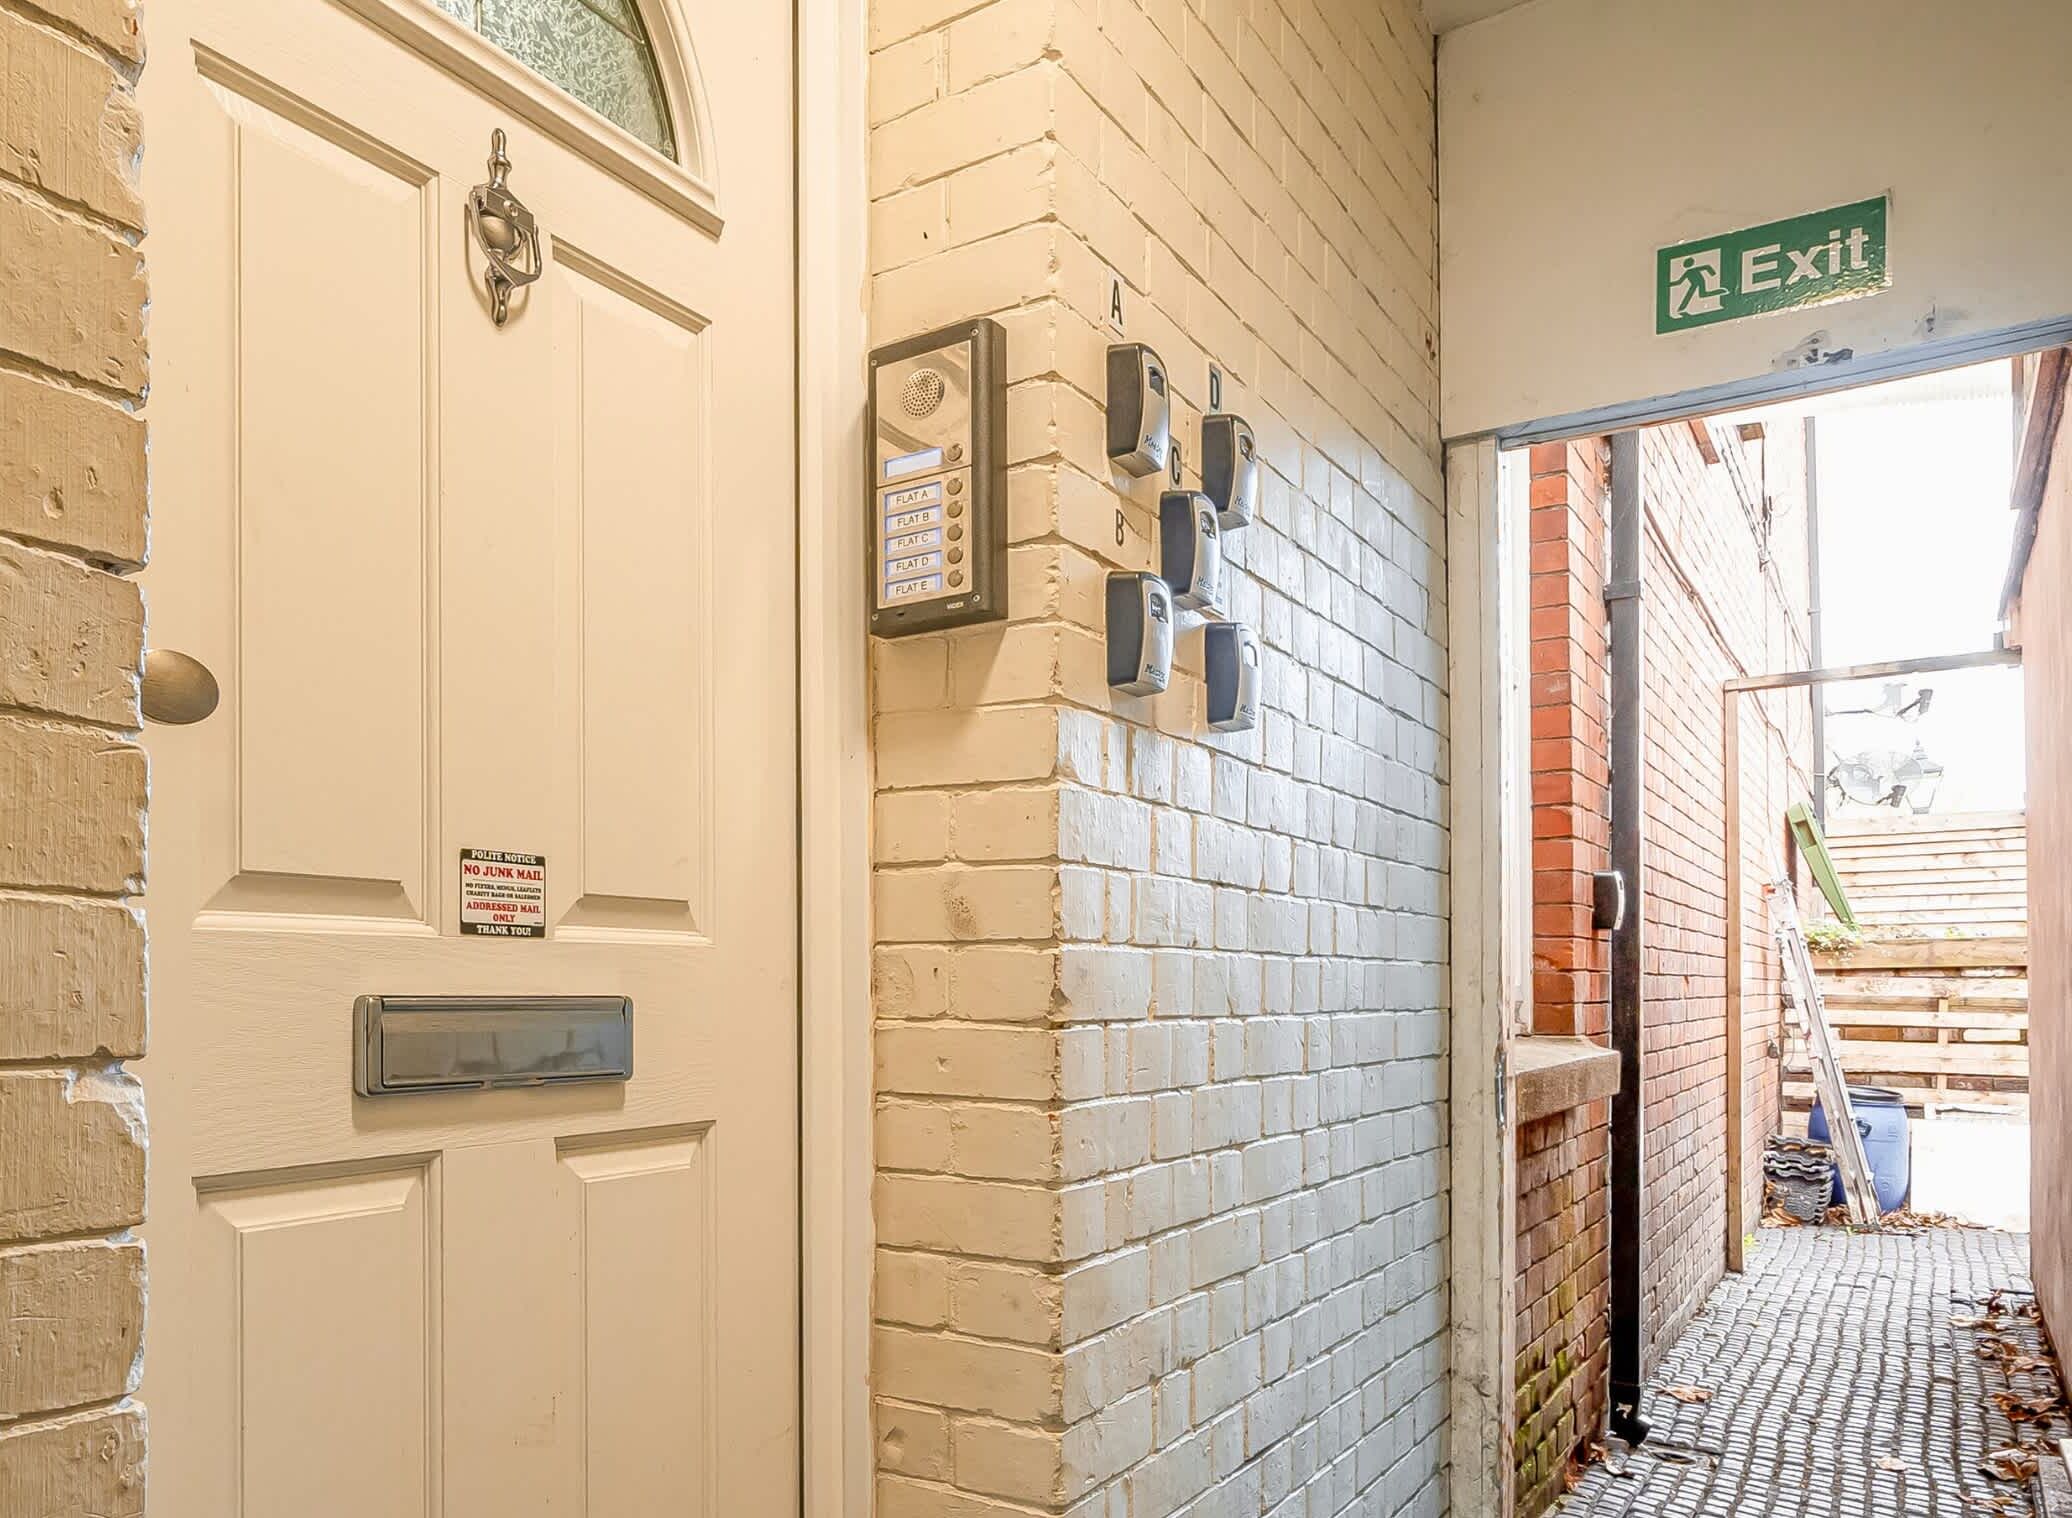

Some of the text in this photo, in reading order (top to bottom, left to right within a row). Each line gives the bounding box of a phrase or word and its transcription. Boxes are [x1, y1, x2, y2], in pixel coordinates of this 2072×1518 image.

[1741, 227, 1869, 294] Exit
[1111, 279, 1123, 326] A
[1210, 369, 1220, 410] D
[1171, 446, 1180, 485] C
[896, 489, 929, 505] FLAT A
[897, 511, 929, 526] FLAT B
[1115, 509, 1125, 546] B
[897, 533, 929, 548] FLAT C
[896, 557, 929, 571] FLAT D
[896, 580, 927, 595] FLAT E
[471, 850, 536, 864] POLITE NOTICE
[464, 864, 543, 880] NO JUNK MAIL
[466, 901, 541, 913] ADDRESSED MAIL
[493, 914, 515, 922] ONLY
[476, 925, 532, 936] THANK YOU!
